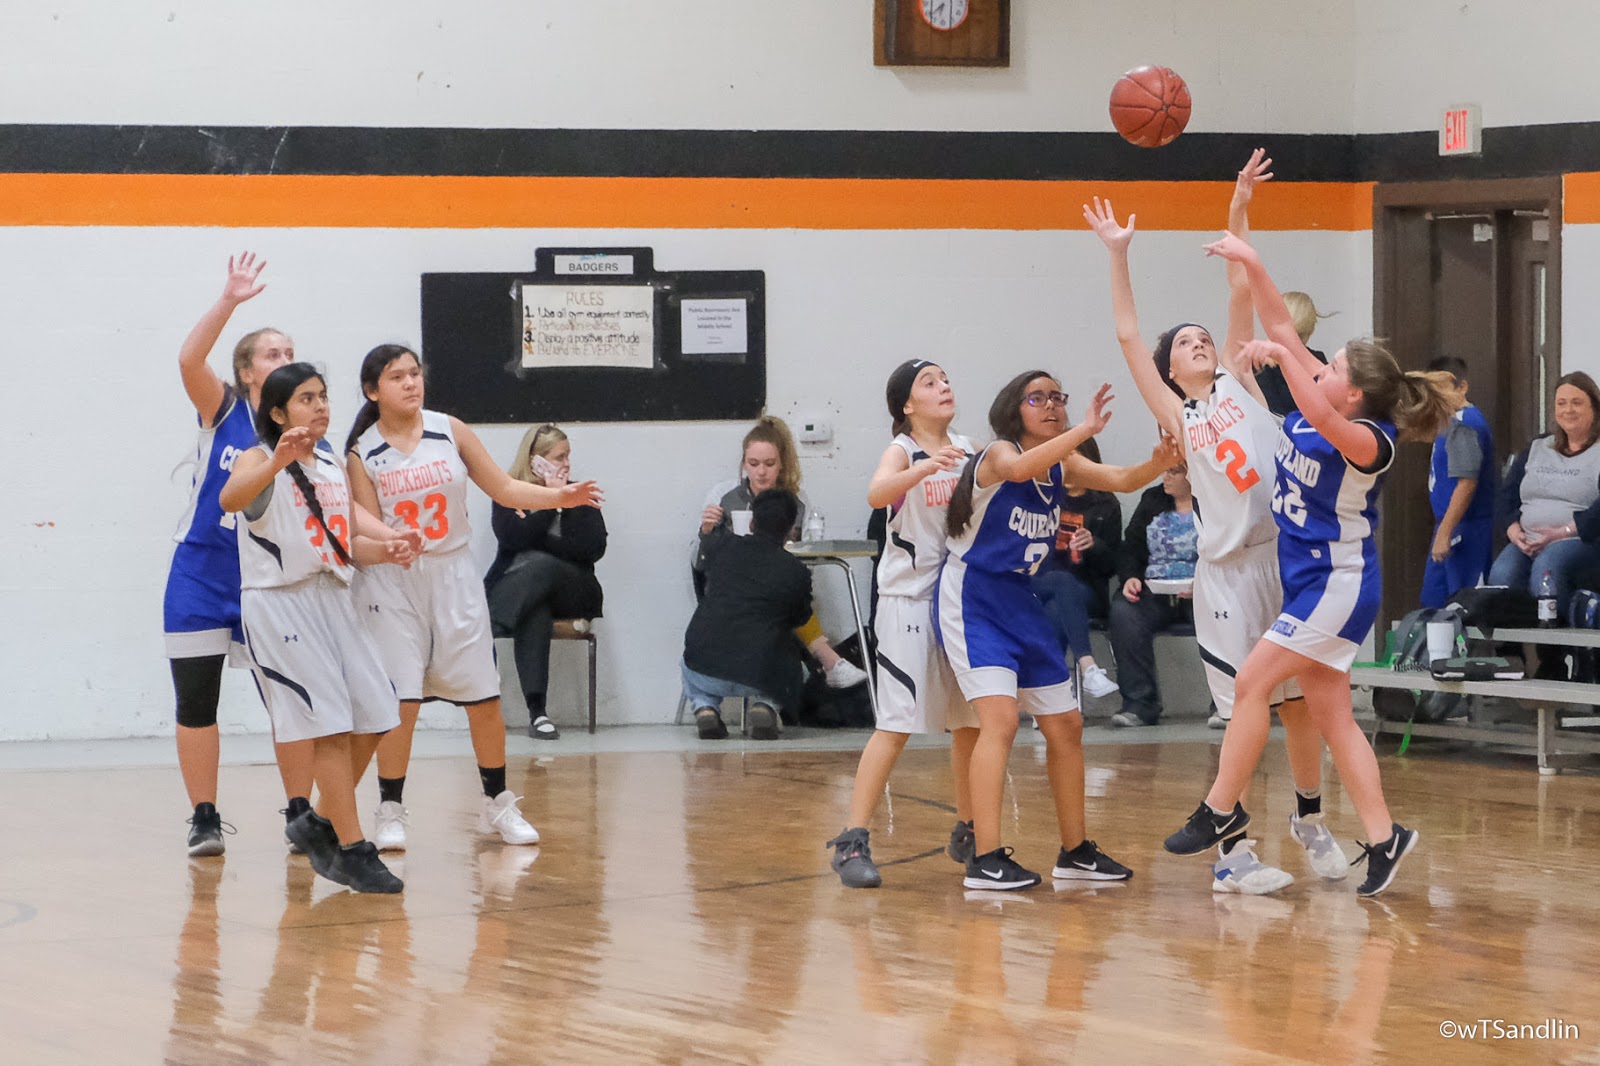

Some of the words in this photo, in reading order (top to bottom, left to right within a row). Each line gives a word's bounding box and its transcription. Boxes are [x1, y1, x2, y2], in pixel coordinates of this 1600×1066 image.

[1446, 110, 1468, 150] EXIT
[568, 262, 619, 271] BADGERS
[525, 305, 535, 318] 1.
[538, 307, 555, 318] Use
[566, 291, 604, 306] RULES
[523, 330, 535, 343] 3.
[379, 460, 453, 497] BUCKHOLTS
[1216, 439, 1260, 494] 2
[394, 492, 449, 540] 33
